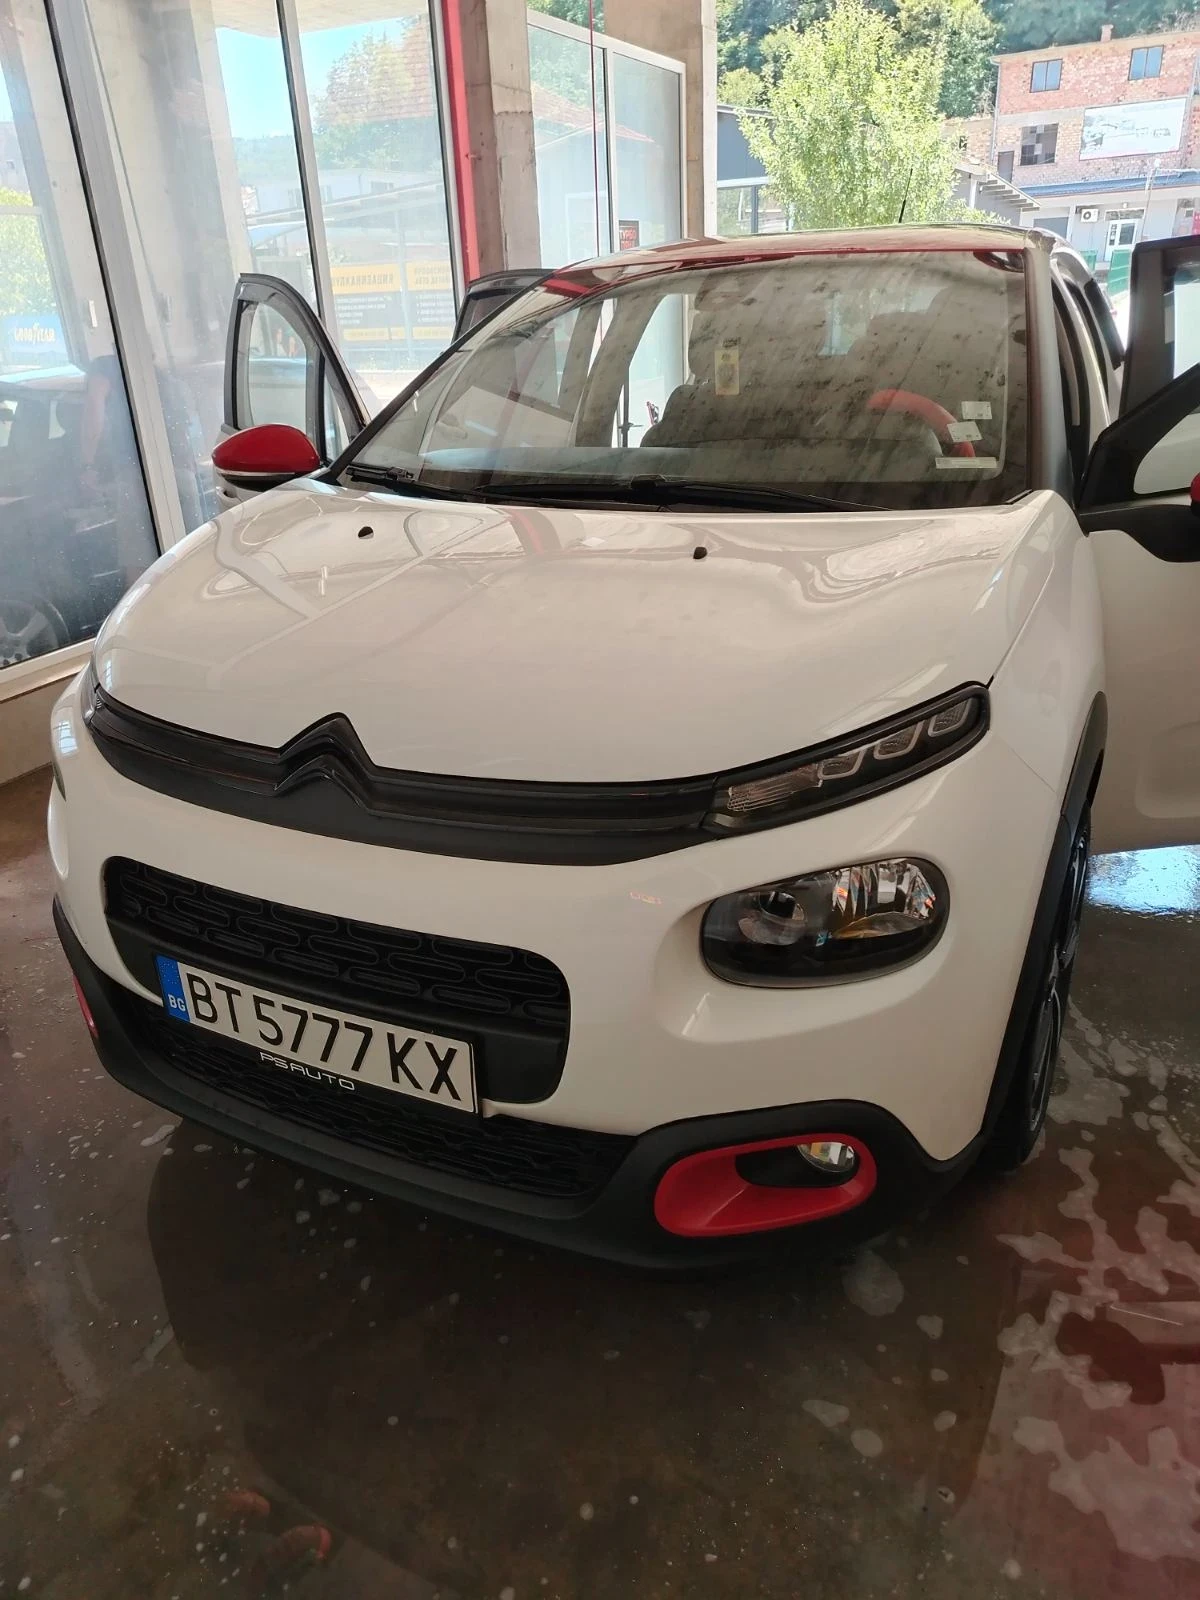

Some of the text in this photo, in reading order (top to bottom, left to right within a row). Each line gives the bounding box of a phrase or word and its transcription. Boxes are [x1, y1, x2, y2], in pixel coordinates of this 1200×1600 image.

[168, 994, 186, 1012] BG
[186, 972, 462, 1102] BT 5777 KX
